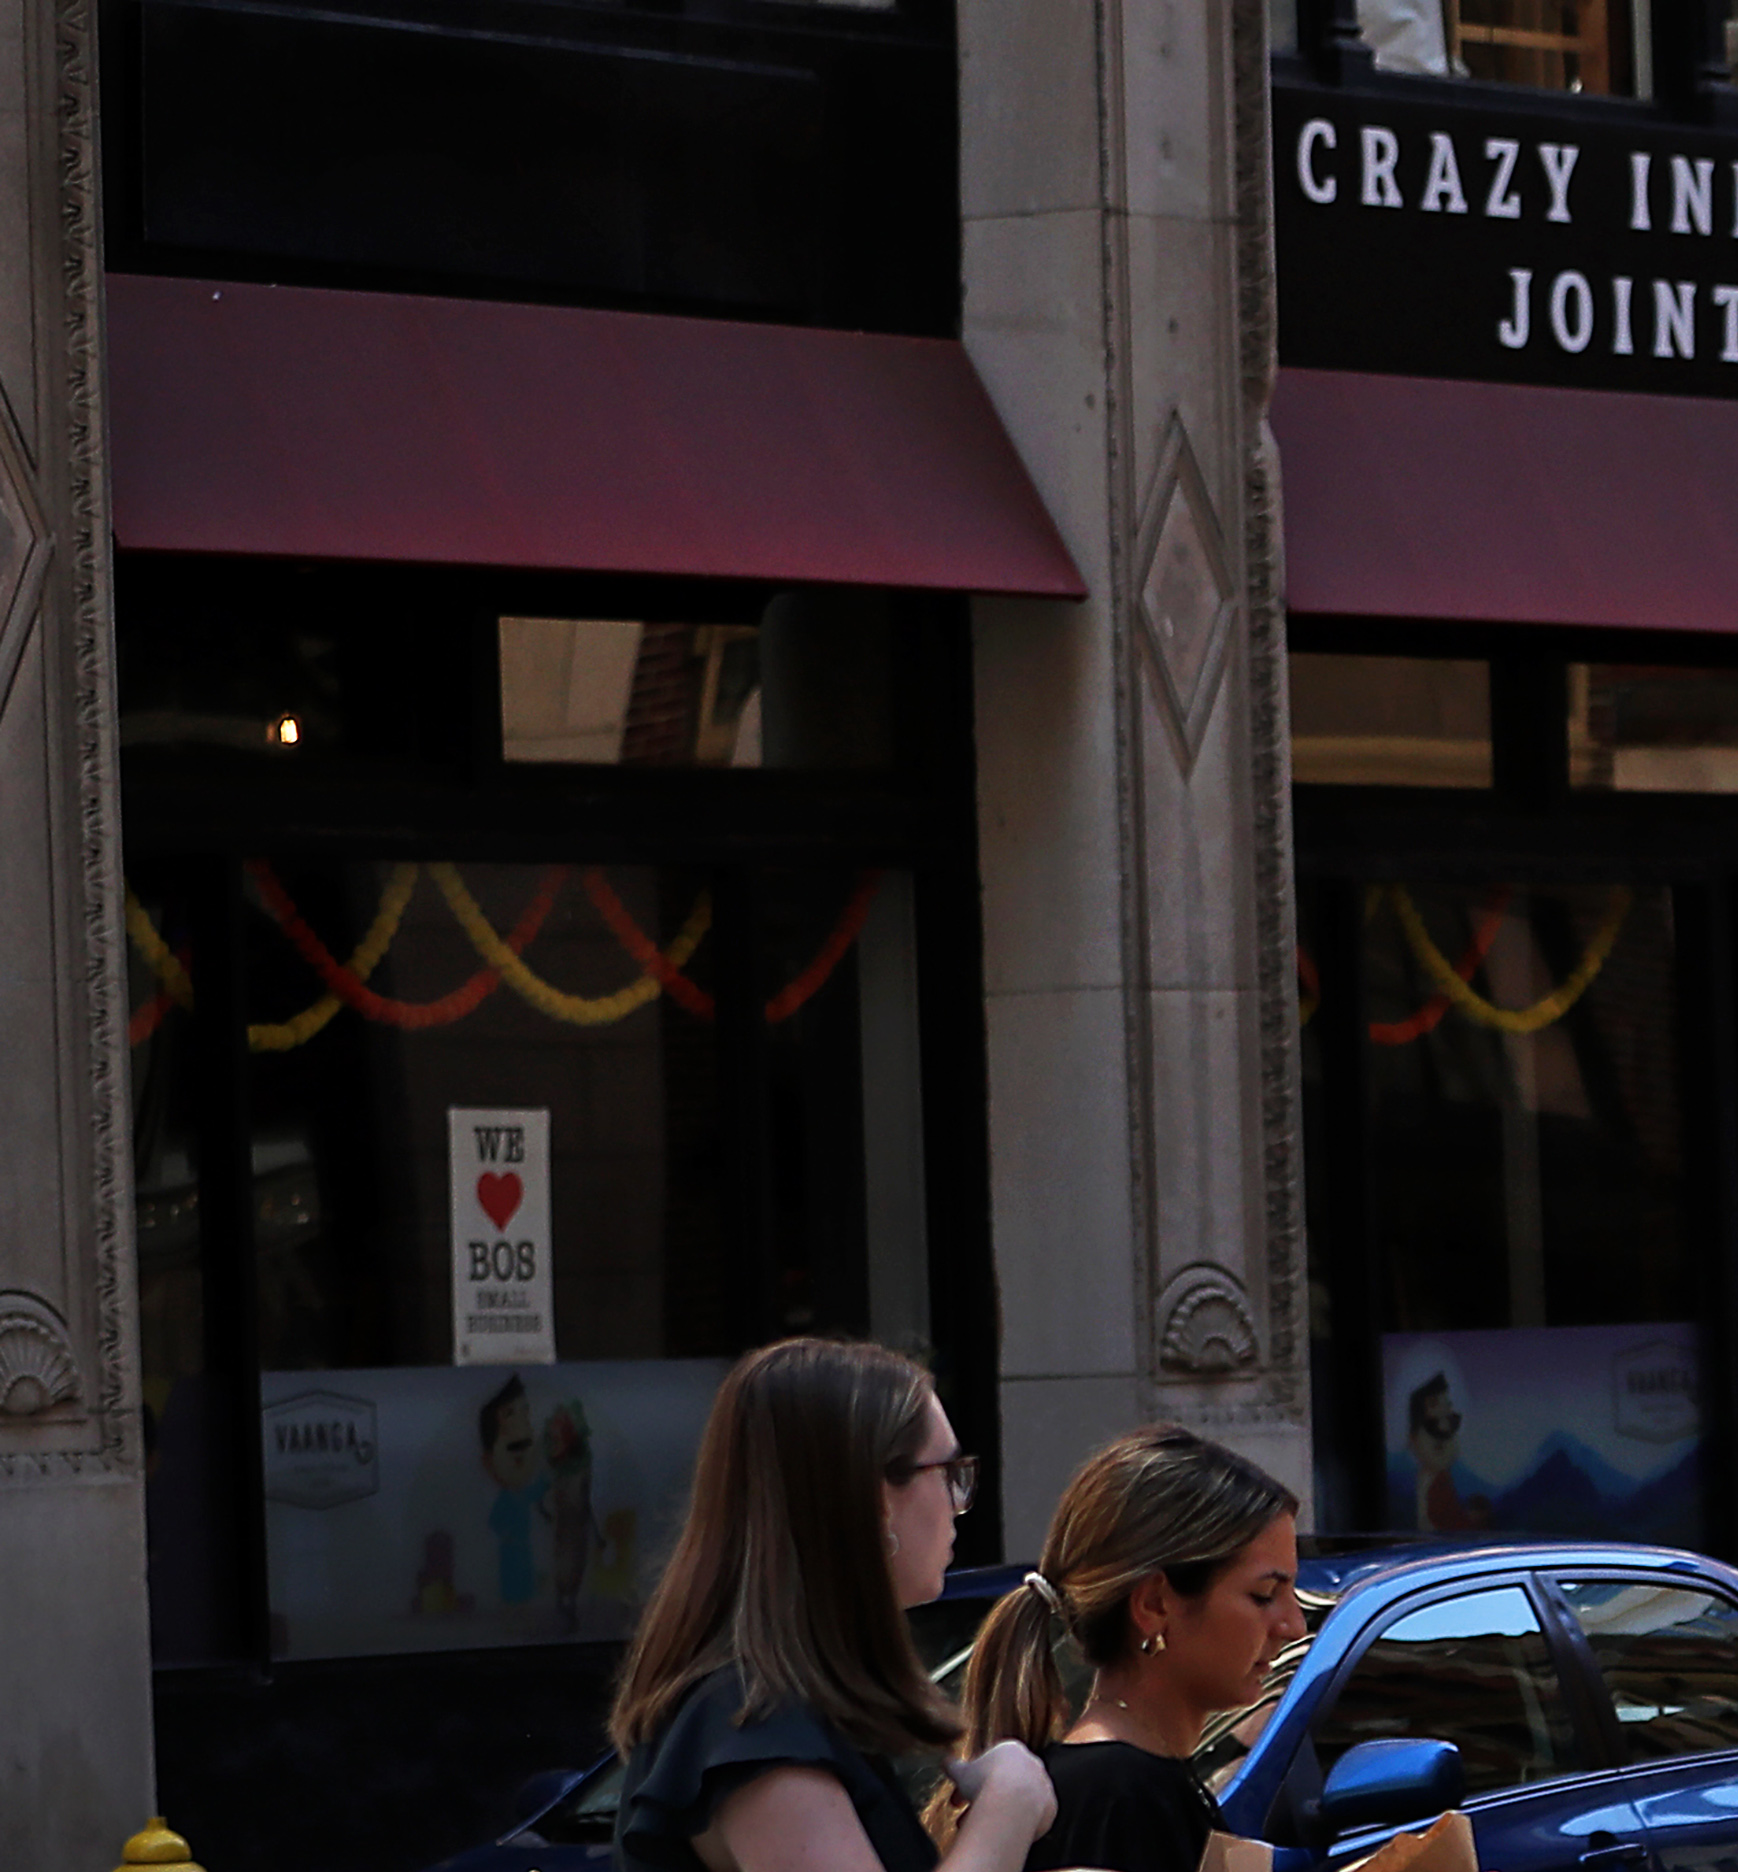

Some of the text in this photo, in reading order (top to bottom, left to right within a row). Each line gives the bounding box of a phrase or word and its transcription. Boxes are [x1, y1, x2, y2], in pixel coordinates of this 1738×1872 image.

[1296, 116, 1582, 225] CRAZY
[473, 1126, 525, 1163] WE
[468, 1241, 537, 1282] BOS
